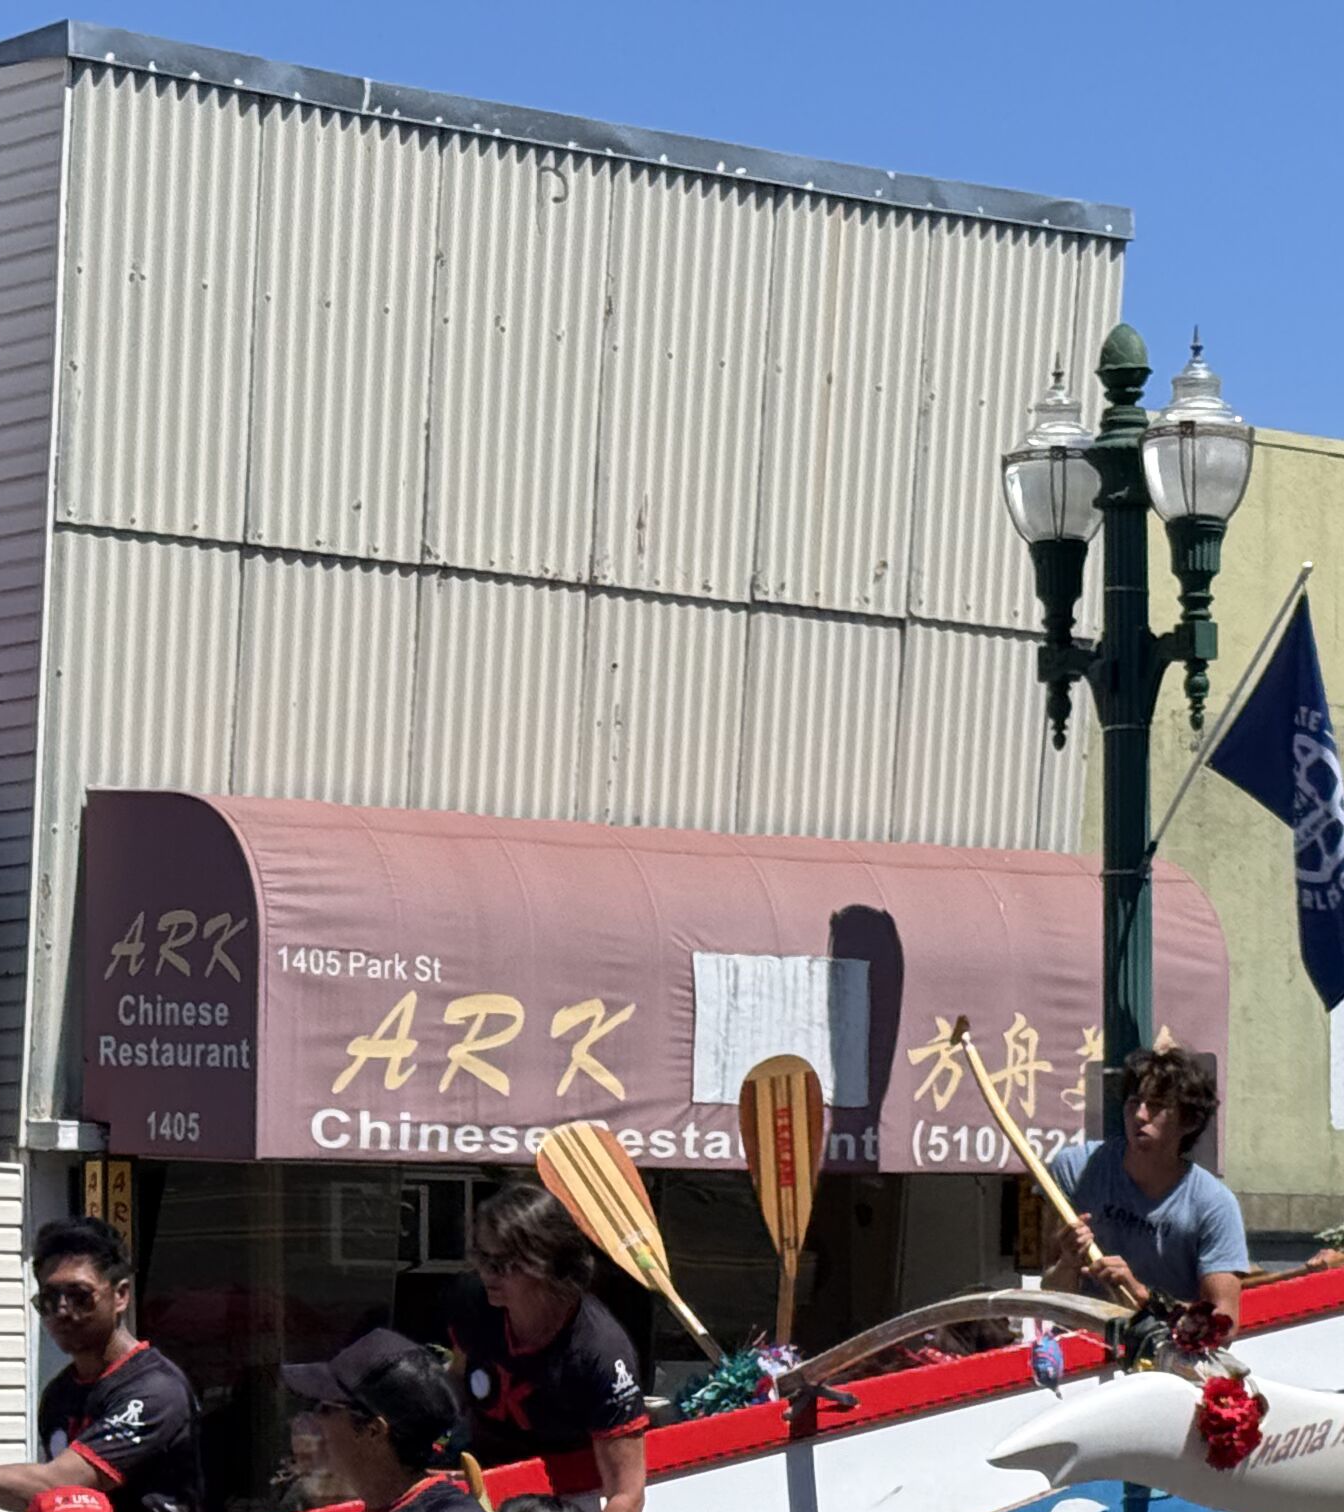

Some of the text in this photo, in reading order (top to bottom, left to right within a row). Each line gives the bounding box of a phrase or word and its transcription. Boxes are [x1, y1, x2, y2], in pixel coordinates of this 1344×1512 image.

[105, 909, 249, 983] ARK
[277, 945, 443, 984] 1405 Park St
[118, 994, 230, 1027] Chinese
[98, 1034, 251, 1069] Restaurant
[331, 989, 638, 1101] ARK
[146, 1110, 201, 1143] 1405
[311, 1107, 550, 1155] Chinese
